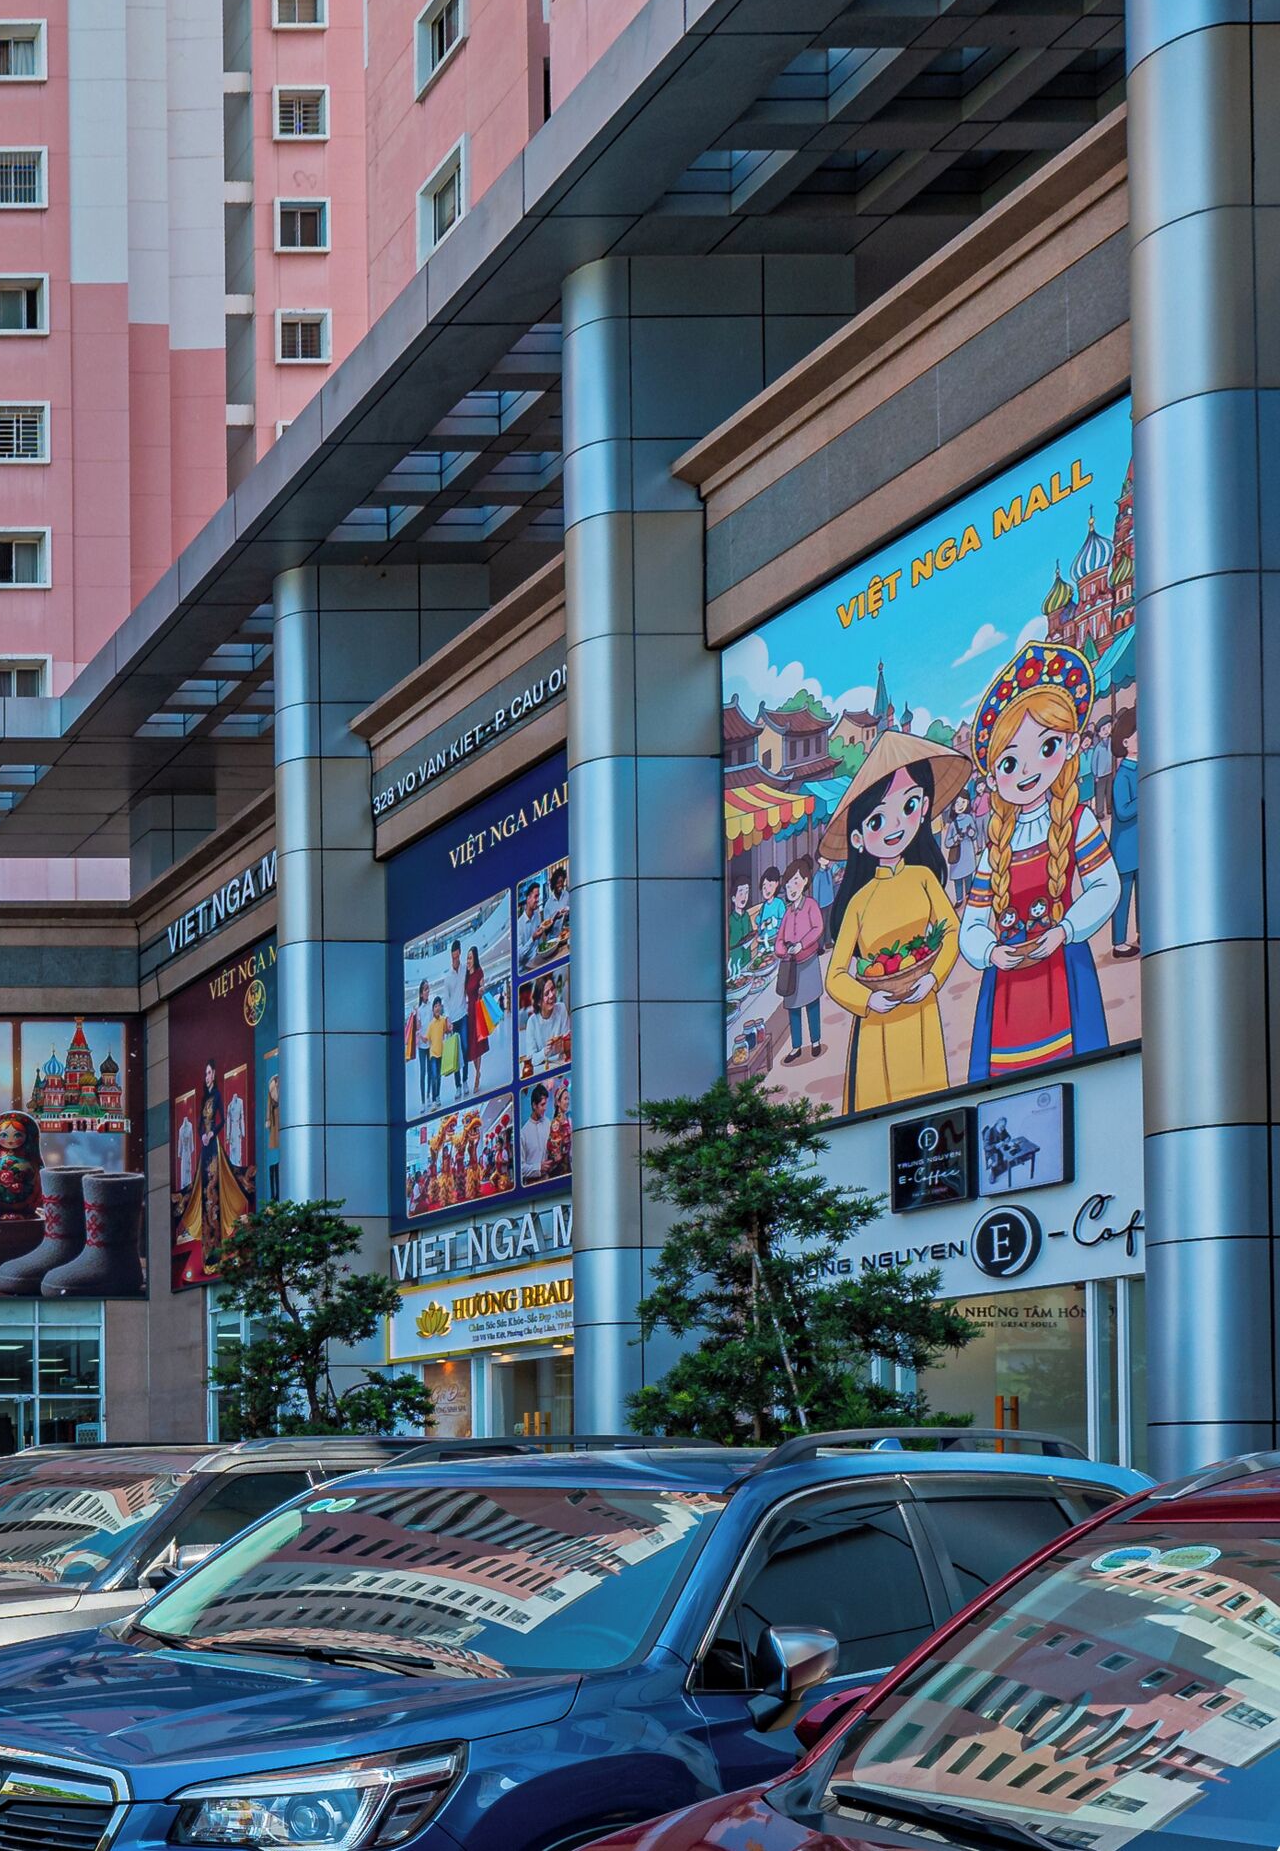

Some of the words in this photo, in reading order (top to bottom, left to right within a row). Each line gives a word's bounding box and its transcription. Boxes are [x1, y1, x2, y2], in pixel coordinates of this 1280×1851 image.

[836, 569, 902, 629] VIỆT
[911, 524, 983, 588] NGA
[993, 459, 1093, 539] MALL
[373, 787, 394, 815] 328
[397, 772, 416, 797] VO
[418, 751, 446, 782] VAN
[450, 724, 482, 763] KIET
[495, 709, 506, 731] P.
[510, 680, 543, 719] CAU
[449, 831, 486, 869] VIỆT
[490, 808, 528, 848] NGA
[167, 901, 207, 953] VIET
[213, 869, 255, 925] NGA
[209, 968, 236, 1000] VIỆT
[238, 952, 265, 985] NGA
[897, 1159, 925, 1169] TRUNG
[927, 1151, 962, 1163] NGUYEN
[393, 1231, 456, 1281] VIET
[467, 1213, 540, 1266] NGA
[861, 1240, 966, 1270] NGUYEN
[1024, 1305, 1053, 1318] TÂM
